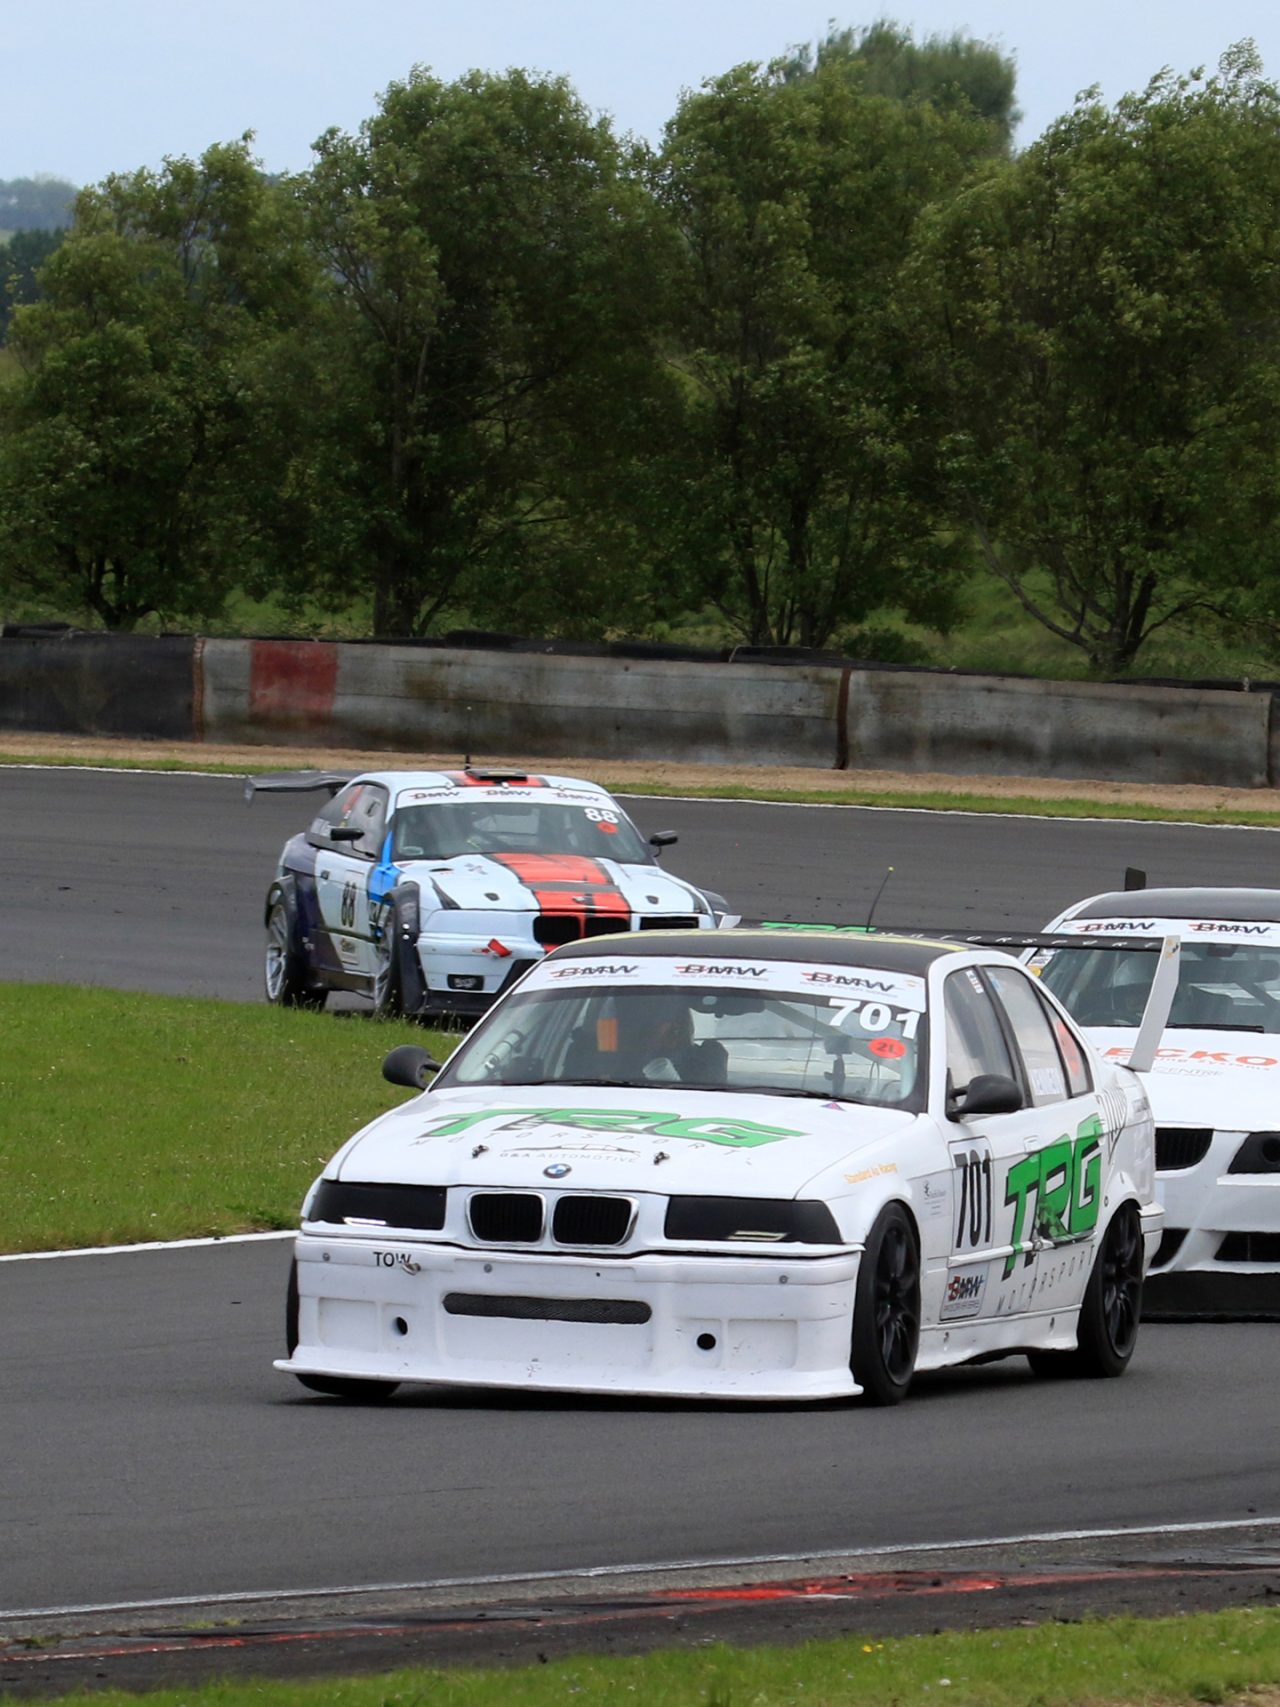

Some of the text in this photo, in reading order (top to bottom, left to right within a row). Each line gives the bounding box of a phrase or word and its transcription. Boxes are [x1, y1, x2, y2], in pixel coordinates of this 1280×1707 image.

[584, 808, 619, 823] 88
[341, 881, 356, 928] 88
[1079, 921, 1155, 932] BMW
[1192, 922, 1270, 934] BMW
[555, 965, 639, 978] BMW
[679, 964, 767, 976] BMW
[805, 972, 894, 991] BMW
[828, 998, 920, 1040] 701
[1096, 1047, 1278, 1067] ECKO
[417, 1107, 811, 1148] TRG
[953, 1149, 991, 1249] 701
[1002, 1112, 1104, 1281] TRG
[373, 1252, 412, 1267] TOW
